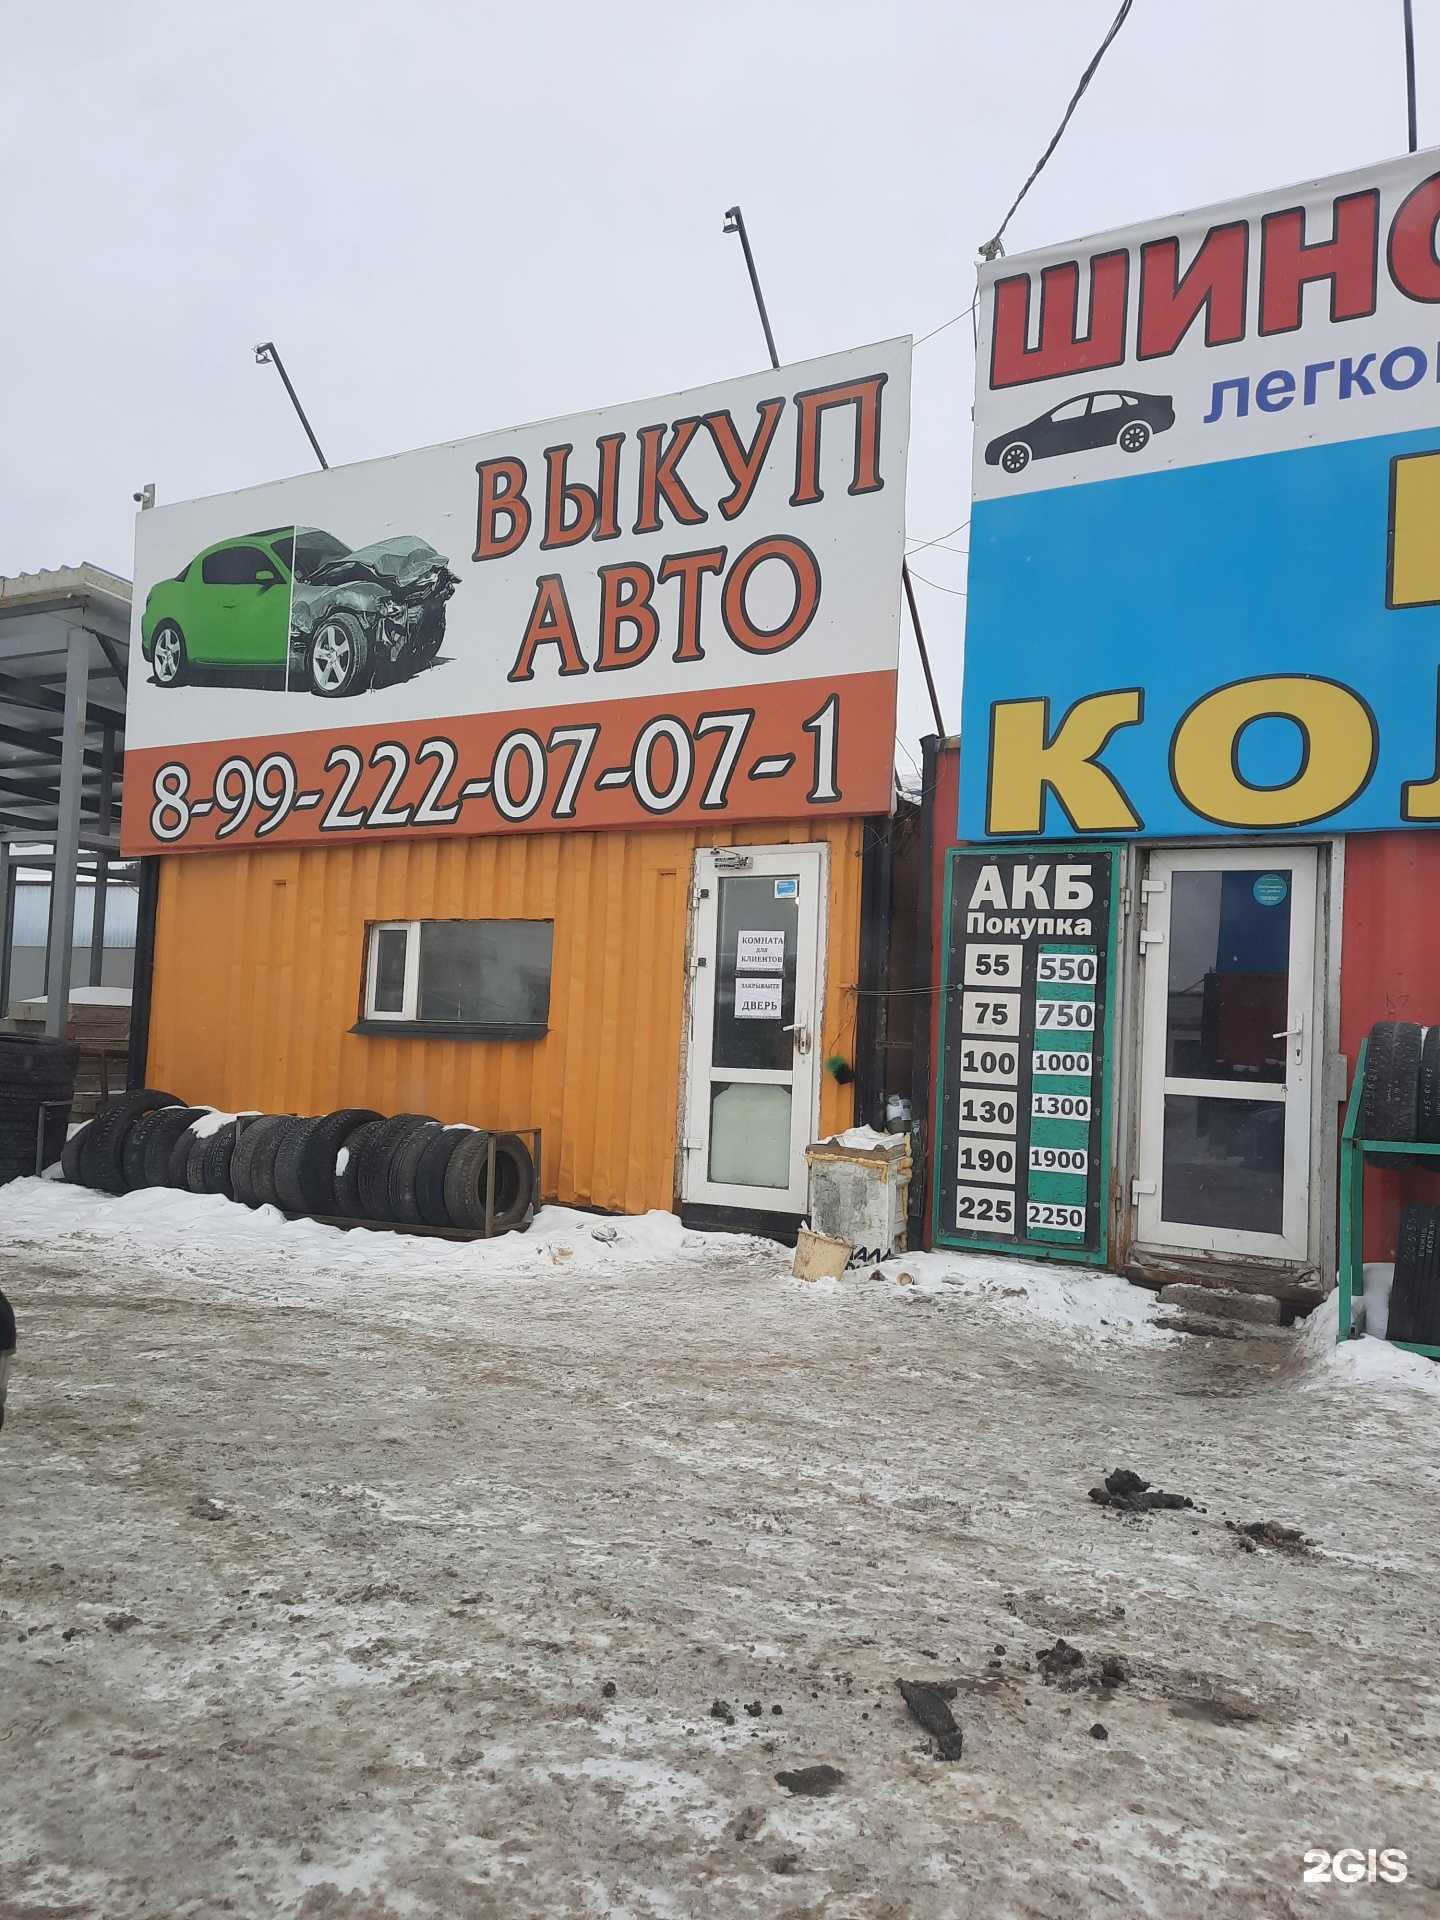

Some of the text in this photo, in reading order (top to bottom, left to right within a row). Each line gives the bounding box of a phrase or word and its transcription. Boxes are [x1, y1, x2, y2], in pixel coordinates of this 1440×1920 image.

[1203, 341, 1440, 424] легко
[472, 372, 889, 562] ВЫКУП
[507, 534, 822, 683] АВТО
[984, 664, 1440, 837] КО
[150, 694, 843, 843] 8-99-222-07-07-1
[967, 864, 1094, 910] АКБ
[966, 911, 1093, 940] Покупка
[742, 936, 784, 945] КОМНАТА
[741, 955, 783, 963] КЛИЕНТОВ
[975, 953, 1095, 981] 55 550
[741, 1001, 778, 1011] ДВЕРЬ
[975, 1002, 1093, 1028] 75 750
[962, 1050, 1090, 1075] 100 1000
[961, 1096, 1088, 1124] 130 1300
[960, 1147, 1085, 1173] 190 1900
[958, 1196, 1083, 1227] 225 2250
